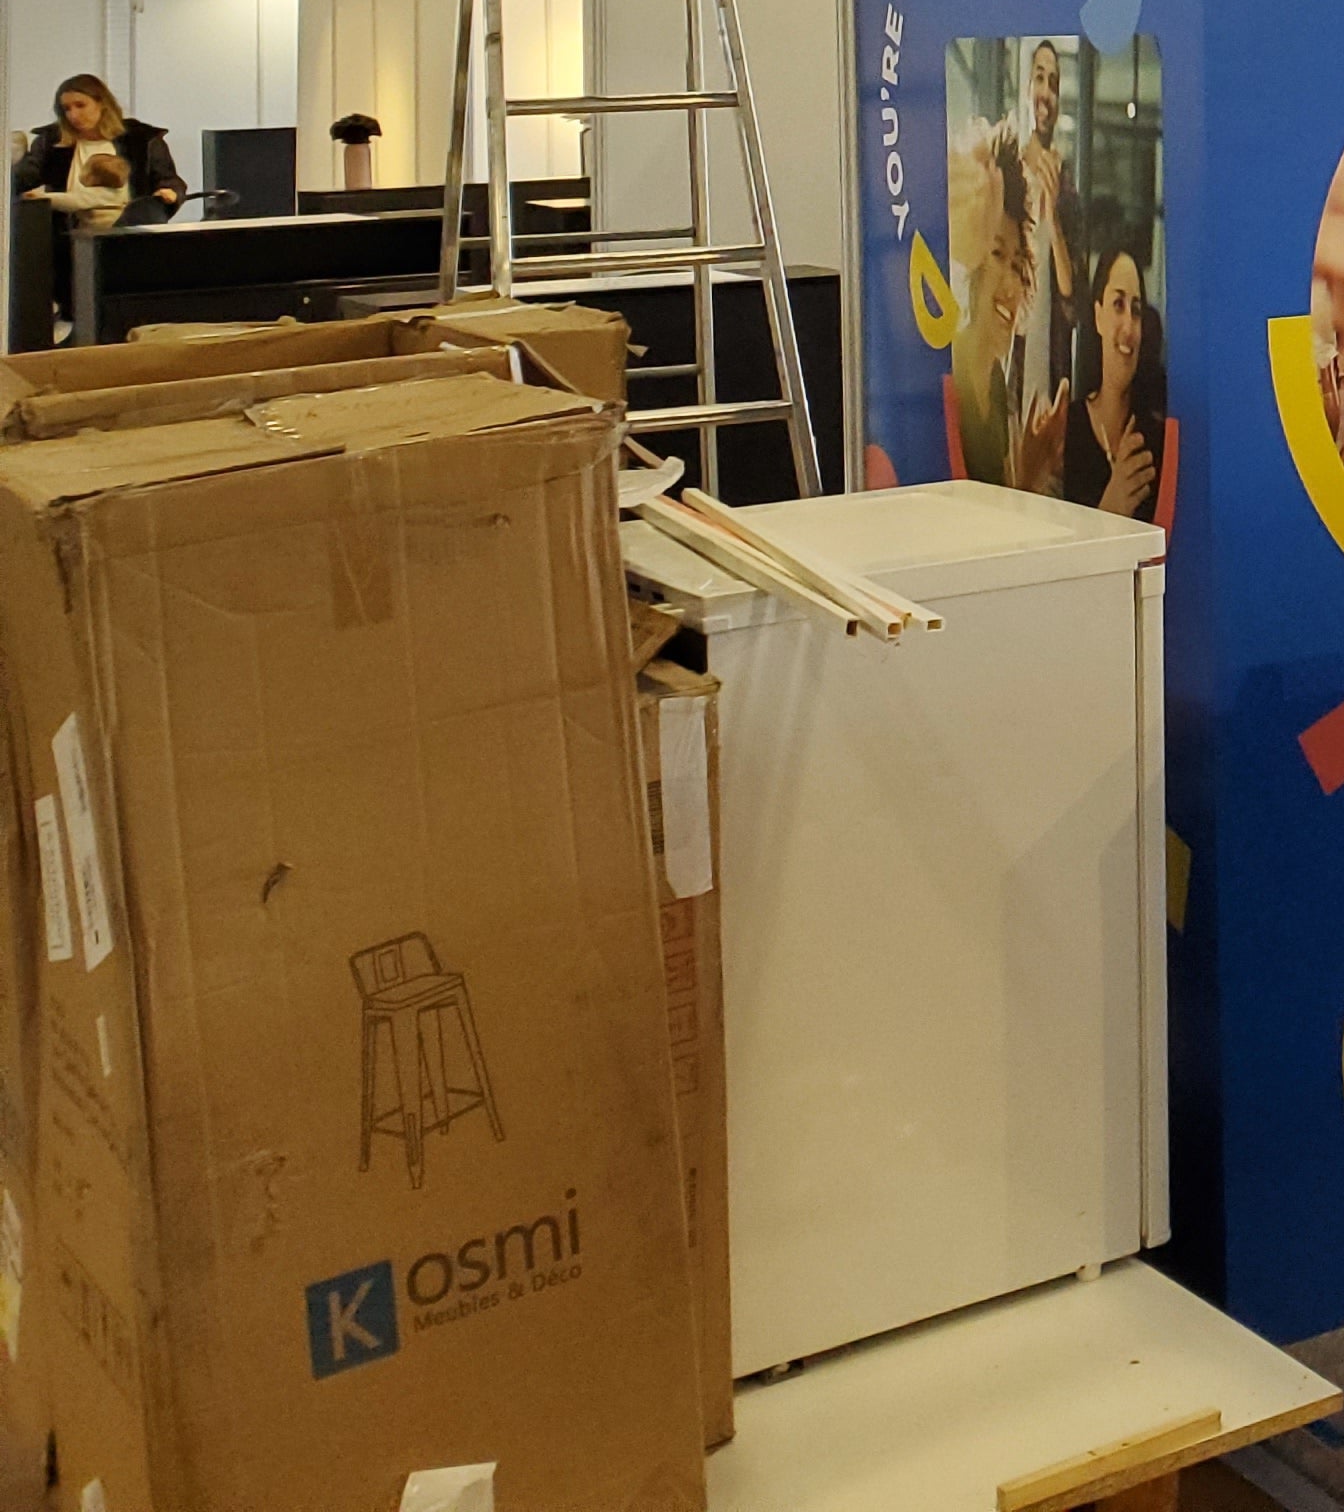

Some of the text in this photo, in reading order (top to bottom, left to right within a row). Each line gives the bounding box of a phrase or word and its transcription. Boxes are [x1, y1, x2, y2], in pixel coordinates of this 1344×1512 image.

[880, 2, 910, 241] YOU'RE
[413, 1292, 500, 1334] Meubles
[531, 1263, 583, 1293] Déco
